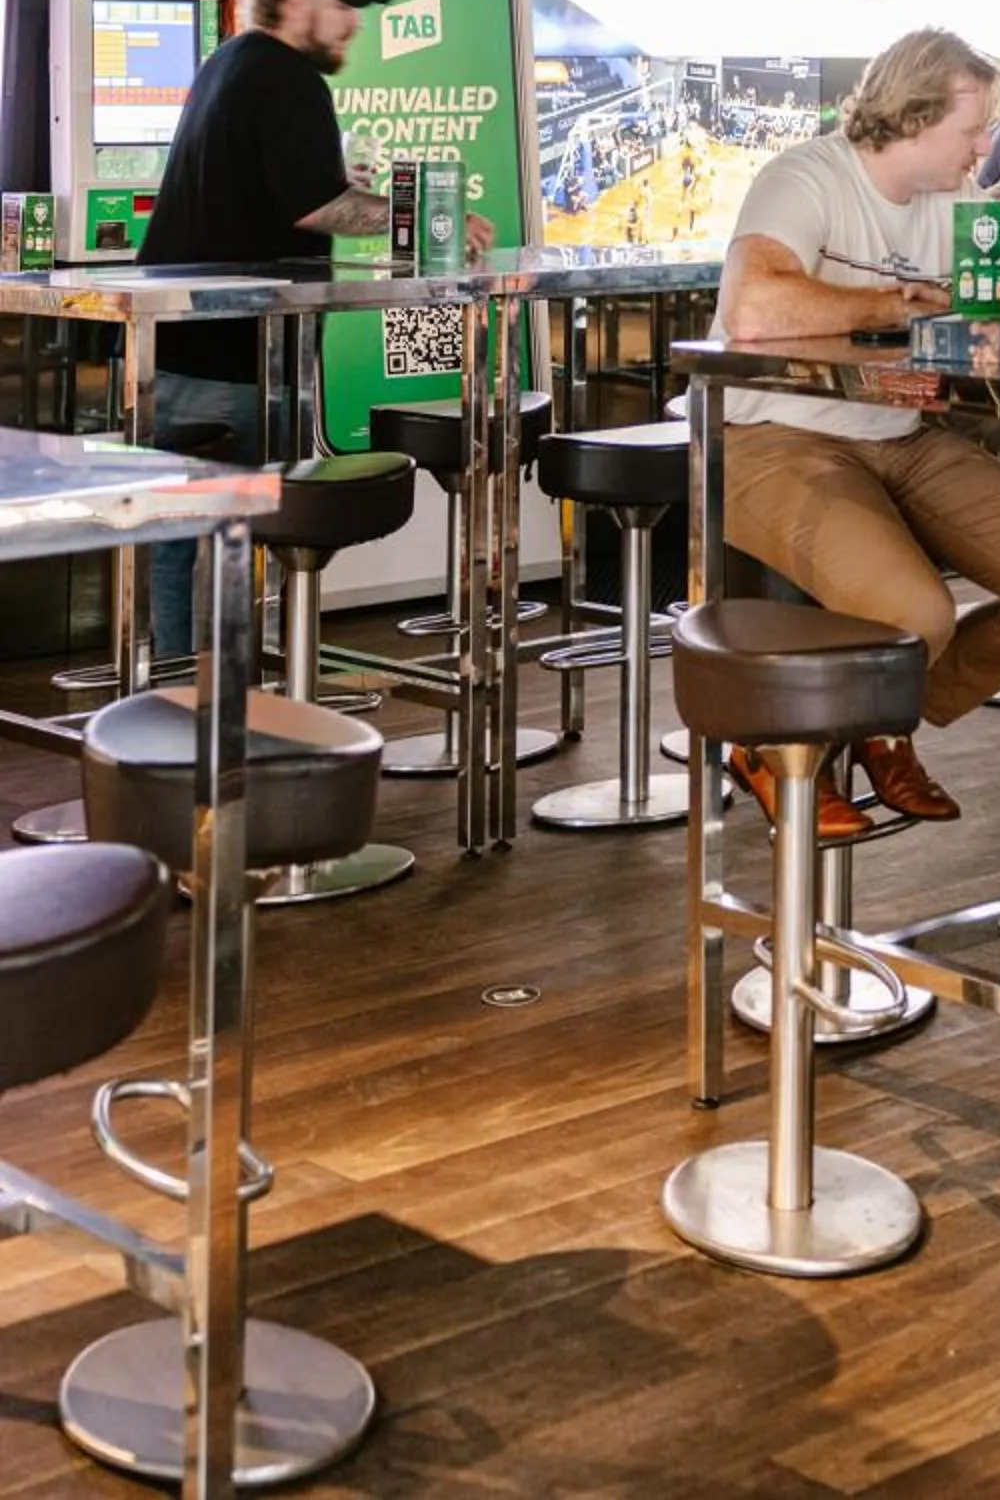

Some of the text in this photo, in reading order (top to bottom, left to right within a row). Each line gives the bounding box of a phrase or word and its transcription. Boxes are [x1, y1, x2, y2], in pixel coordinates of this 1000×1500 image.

[386, 14, 437, 39] TAB
[333, 85, 498, 116] UNRIVALLED
[351, 116, 484, 143] CONTENT
